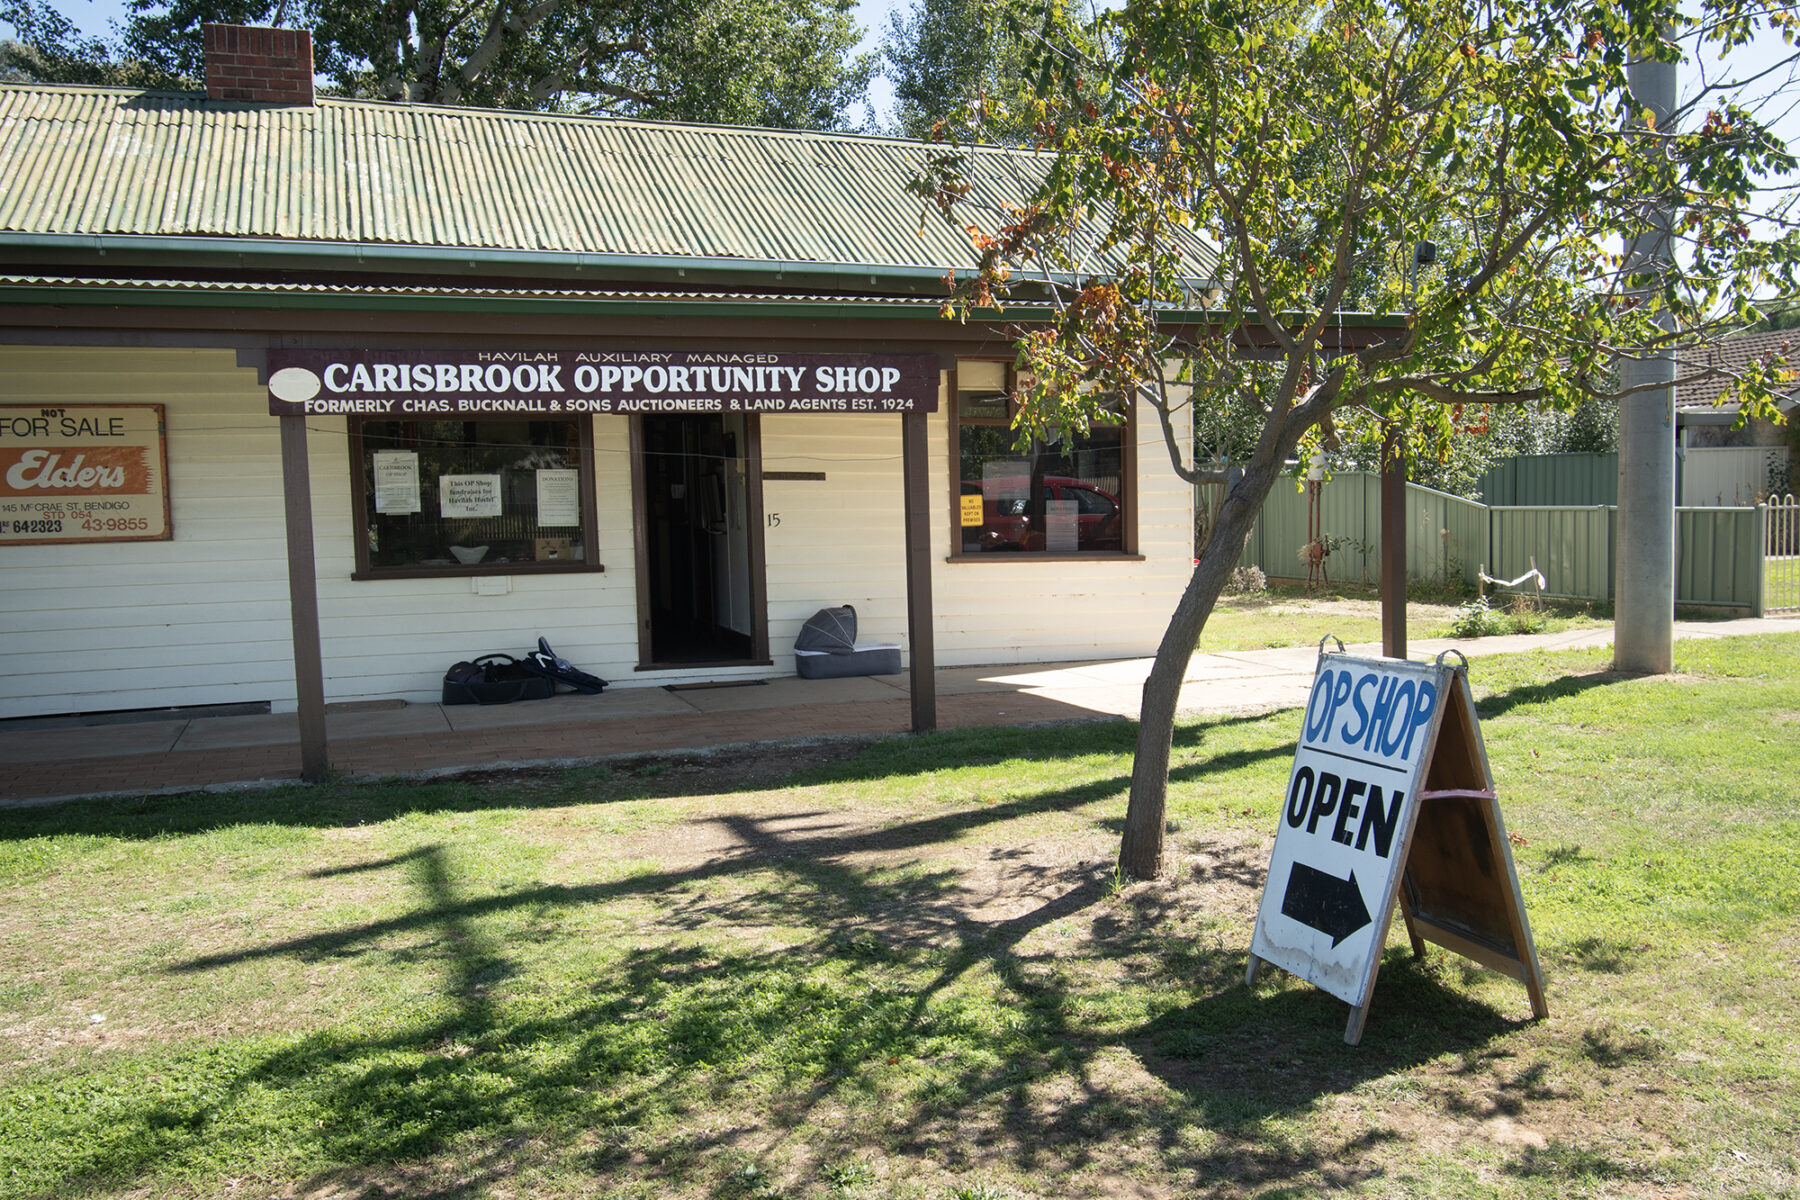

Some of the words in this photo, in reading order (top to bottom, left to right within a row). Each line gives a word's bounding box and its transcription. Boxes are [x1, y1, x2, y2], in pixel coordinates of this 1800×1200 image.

[478, 352, 558, 362] HAVILAH
[575, 353, 673, 362] AUXILIARY
[686, 354, 779, 363] MANAGED
[323, 363, 565, 393] CARISBROOK
[574, 365, 807, 393] OPPORTUNITY
[815, 366, 901, 393] SHOP
[304, 399, 395, 413] FORMERLY
[402, 399, 454, 412] CHAS.
[458, 399, 546, 412] BUCKNALL
[550, 399, 562, 412] &
[566, 399, 611, 412] SONS
[617, 398, 722, 411] AUCTIONEERS
[729, 398, 741, 411] &
[744, 398, 786, 410] LAND
[788, 398, 847, 410] AGENTS
[851, 398, 877, 410] EST.
[881, 398, 914, 410] 1924
[41, 409, 66, 418] NOT
[0, 417, 50, 437] FOR
[60, 417, 125, 437] SALE
[6, 449, 125, 490] Elders
[84, 501, 130, 511] BENDIGO
[42, 511, 66, 520] STD
[71, 510, 93, 519] 054
[767, 513, 781, 527] 15
[13, 520, 63, 534] 642323
[1286, 765, 1405, 859] OPEN
